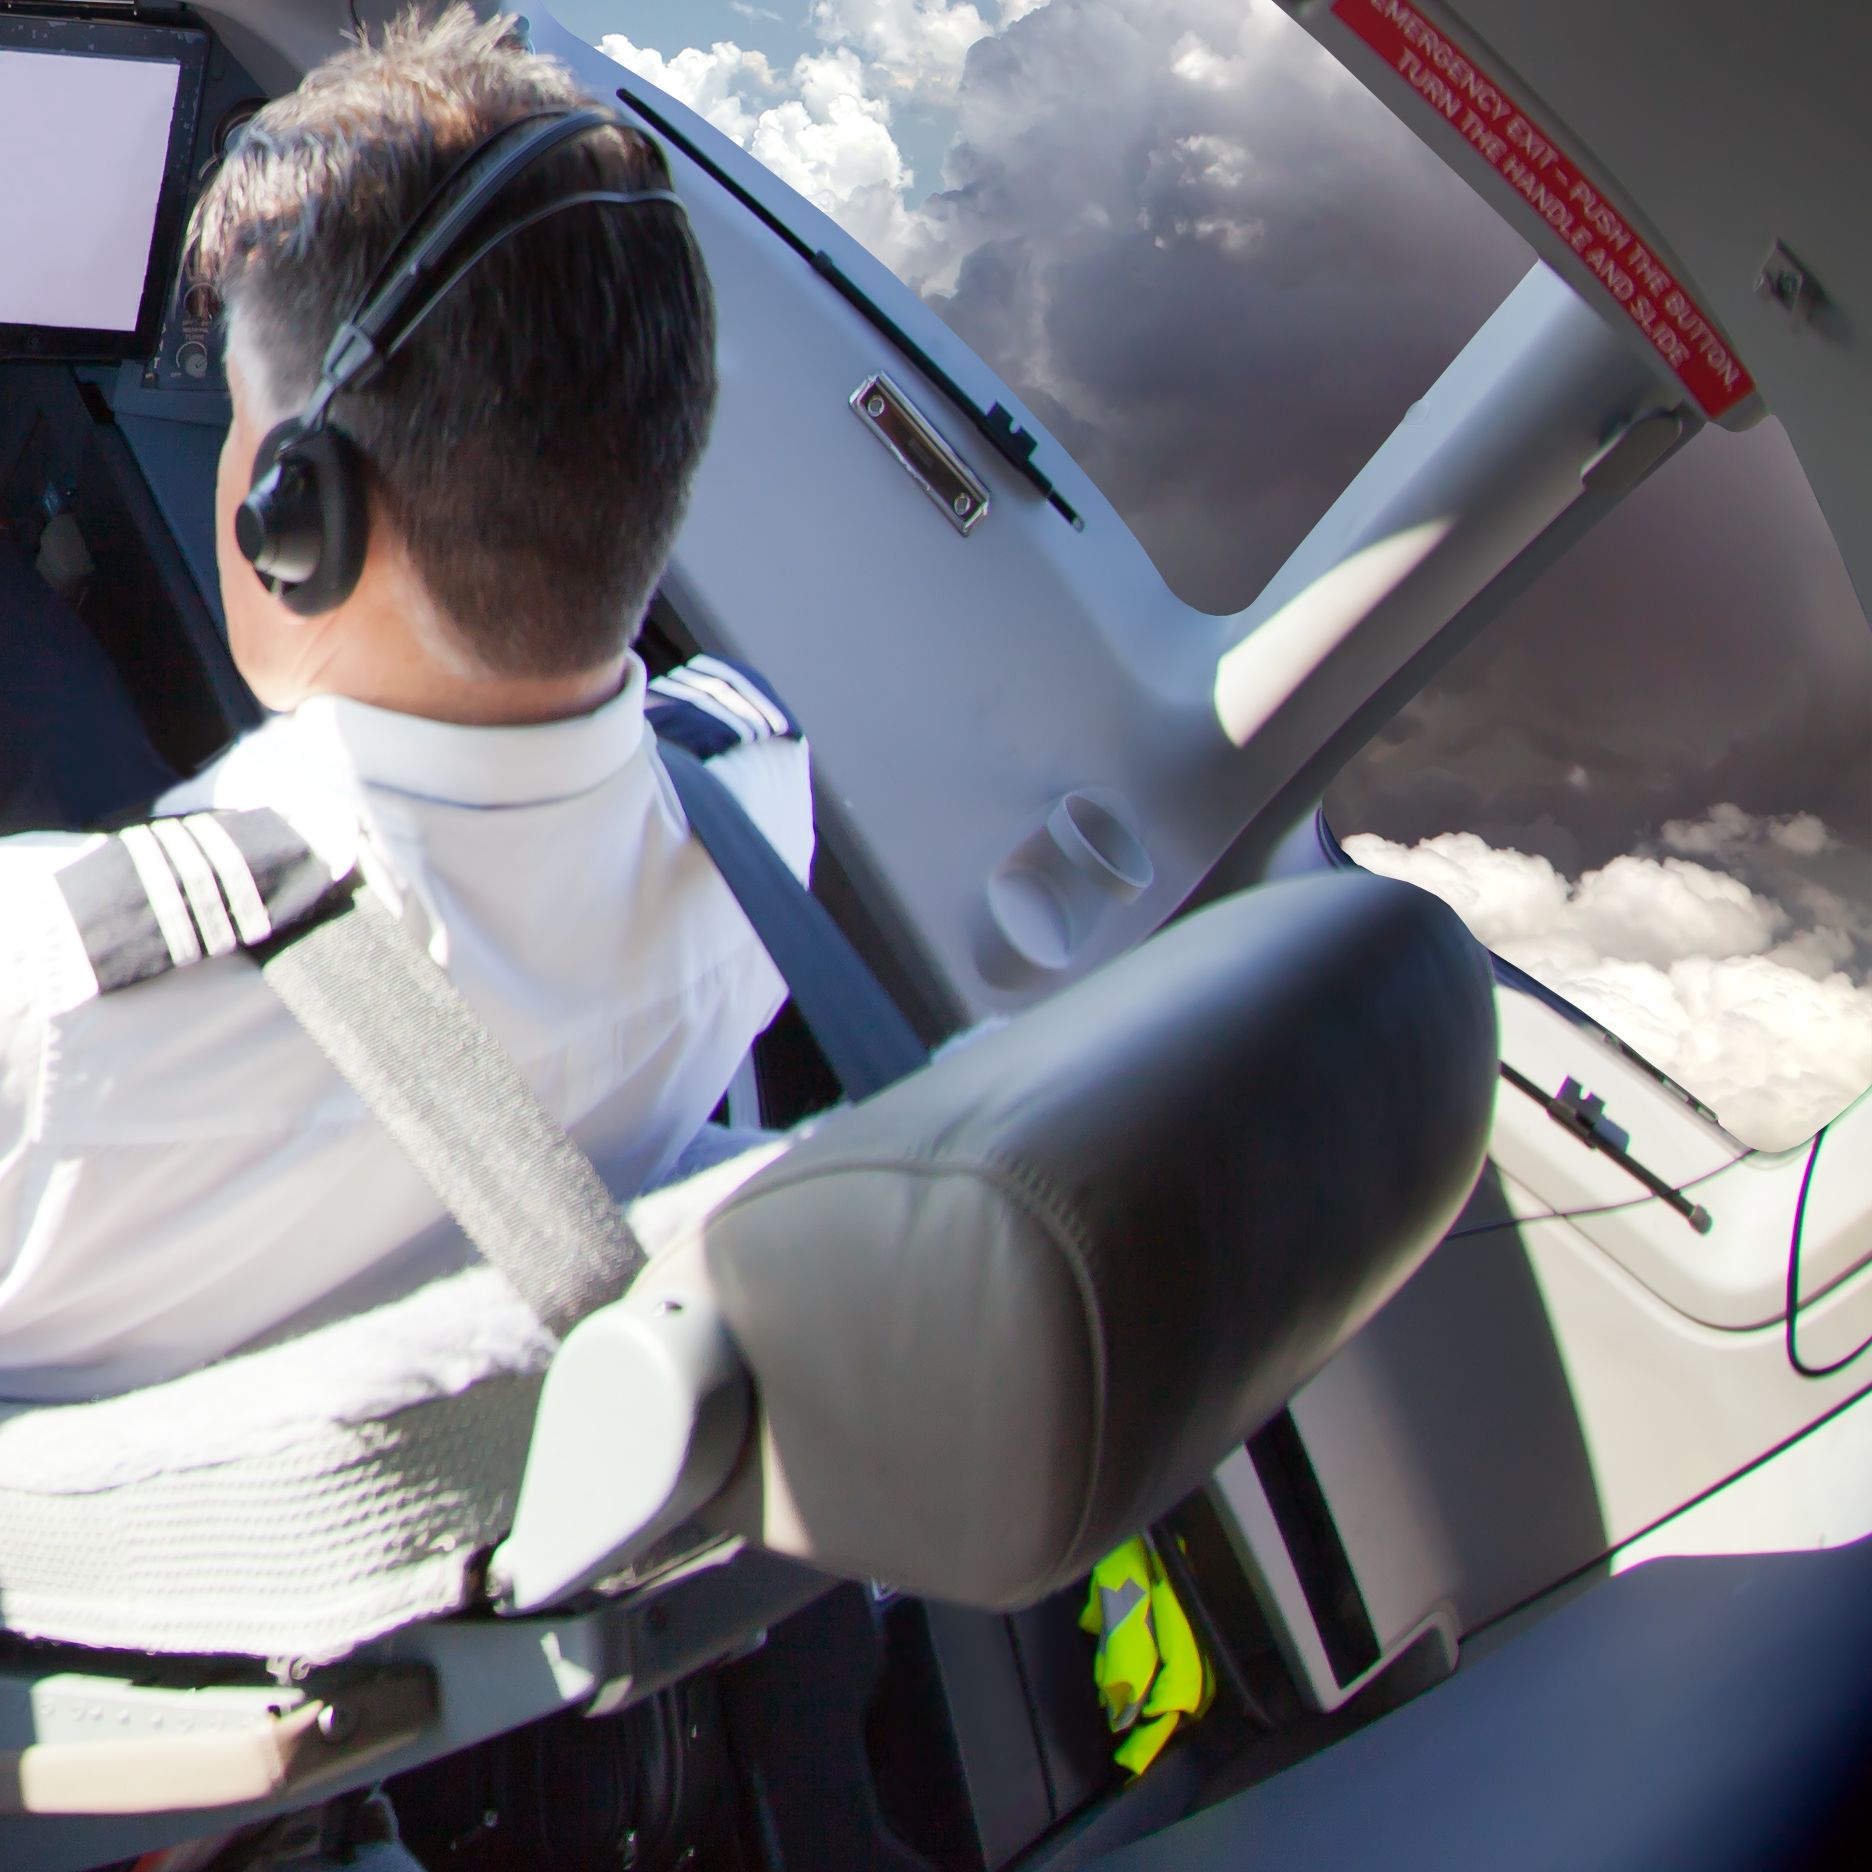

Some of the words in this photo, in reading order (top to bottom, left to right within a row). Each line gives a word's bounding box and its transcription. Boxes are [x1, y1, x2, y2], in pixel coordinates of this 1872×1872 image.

[1398, 45, 1462, 119] TURN
[1461, 106, 1506, 165] THE
[1503, 155, 1593, 254] HANDLE
[1585, 247, 1635, 301] AND
[1629, 295, 1690, 369] SLIDE
[1506, 114, 1559, 169] EXIT
[1569, 180, 1632, 252] PUSH
[1628, 242, 1672, 299] THE
